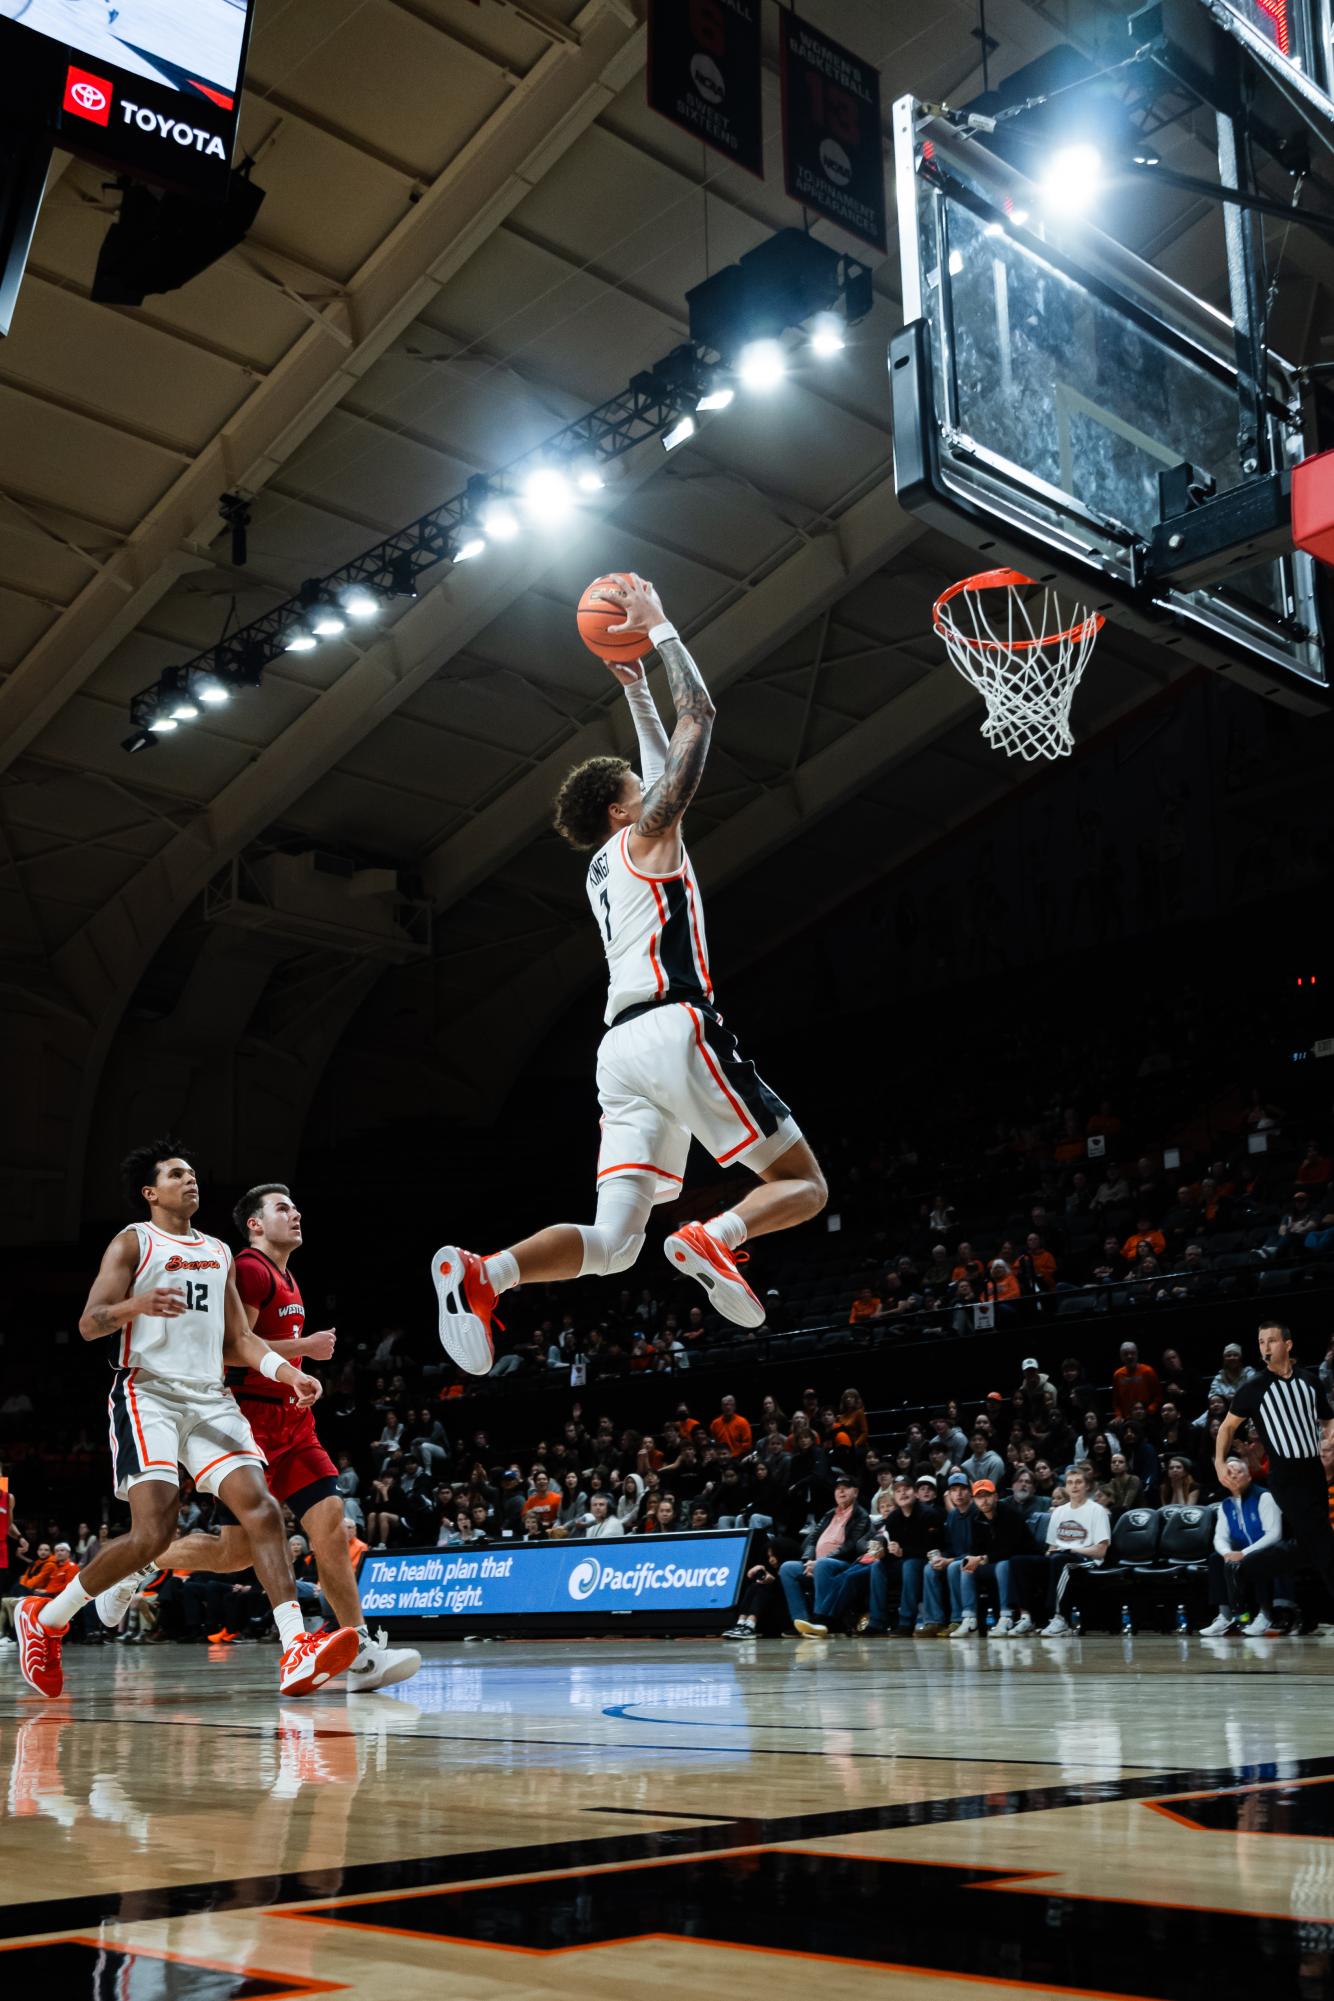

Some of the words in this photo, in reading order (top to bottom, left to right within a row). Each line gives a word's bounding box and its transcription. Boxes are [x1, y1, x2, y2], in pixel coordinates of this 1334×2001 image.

[789, 37, 873, 104] BASKETBALL
[686, 91, 730, 129] SWEET
[120, 99, 226, 161] TOYOTA
[795, 175, 879, 236] APPEARANCES
[796, 164, 876, 221] TOURNAMENT
[165, 1255, 220, 1271] Beavers
[186, 1280, 208, 1312] 12
[370, 1562, 397, 1583] The
[397, 1559, 444, 1582] health
[442, 1557, 479, 1586] plan
[480, 1556, 513, 1578] that
[598, 1561, 730, 1596] PacificSource
[361, 1588, 396, 1610] does
[398, 1586, 445, 1609] what's
[444, 1584, 484, 1613] right.
